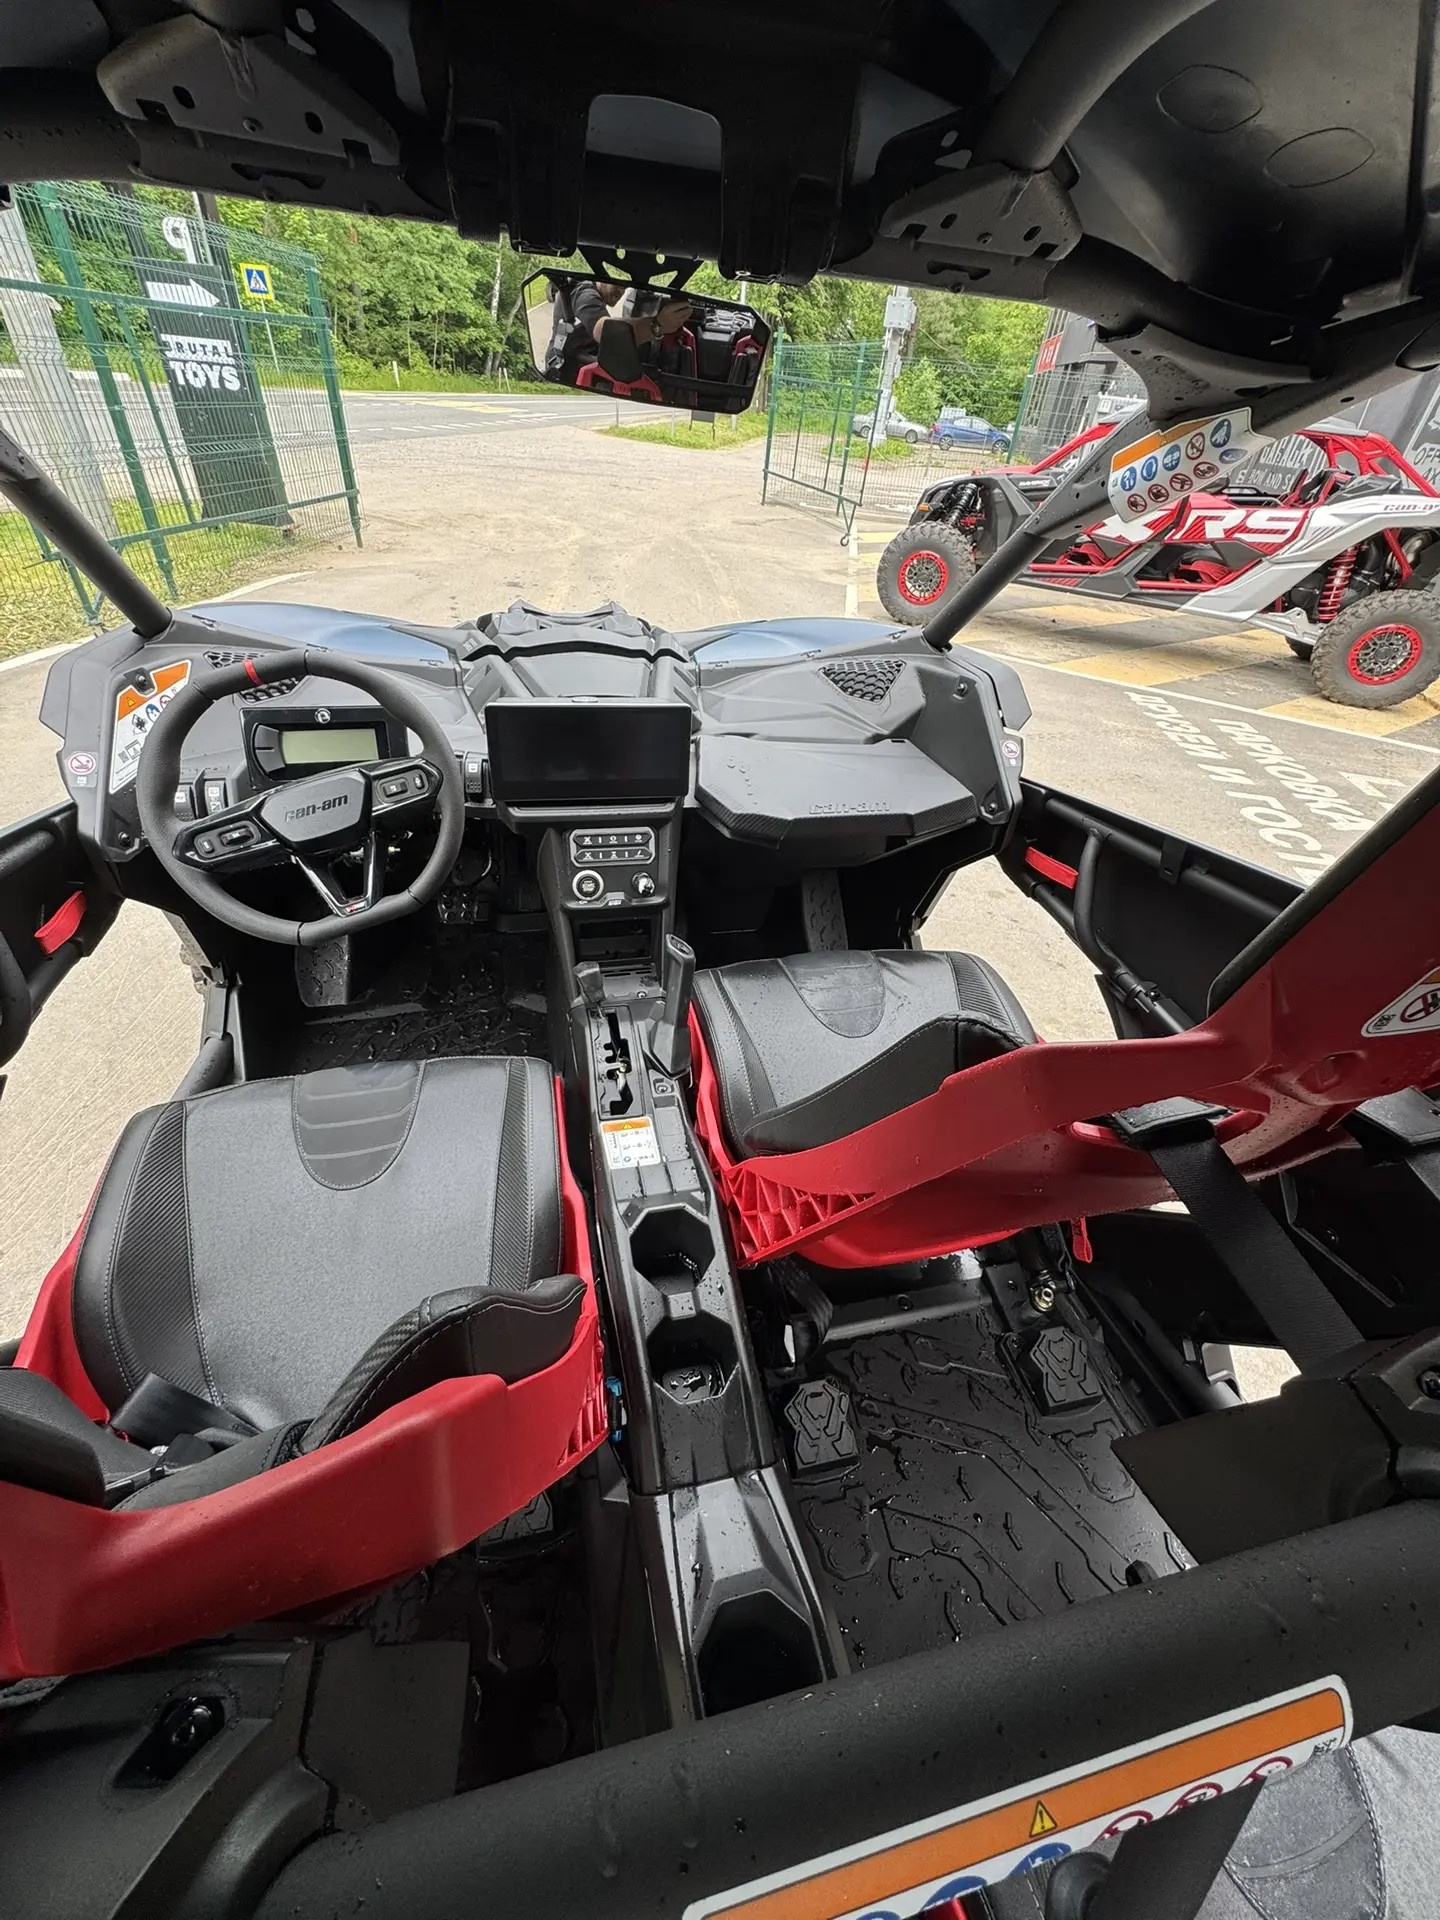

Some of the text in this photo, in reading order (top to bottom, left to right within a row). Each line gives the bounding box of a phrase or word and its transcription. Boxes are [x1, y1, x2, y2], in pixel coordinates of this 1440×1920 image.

[168, 361, 241, 391] TOYS
[1124, 691, 1338, 886] ДРУЗЕЙ И ГОСТ
[1209, 717, 1376, 831] ПАРКОВКА
[285, 794, 348, 823] can-am
[808, 800, 891, 815] can-am
